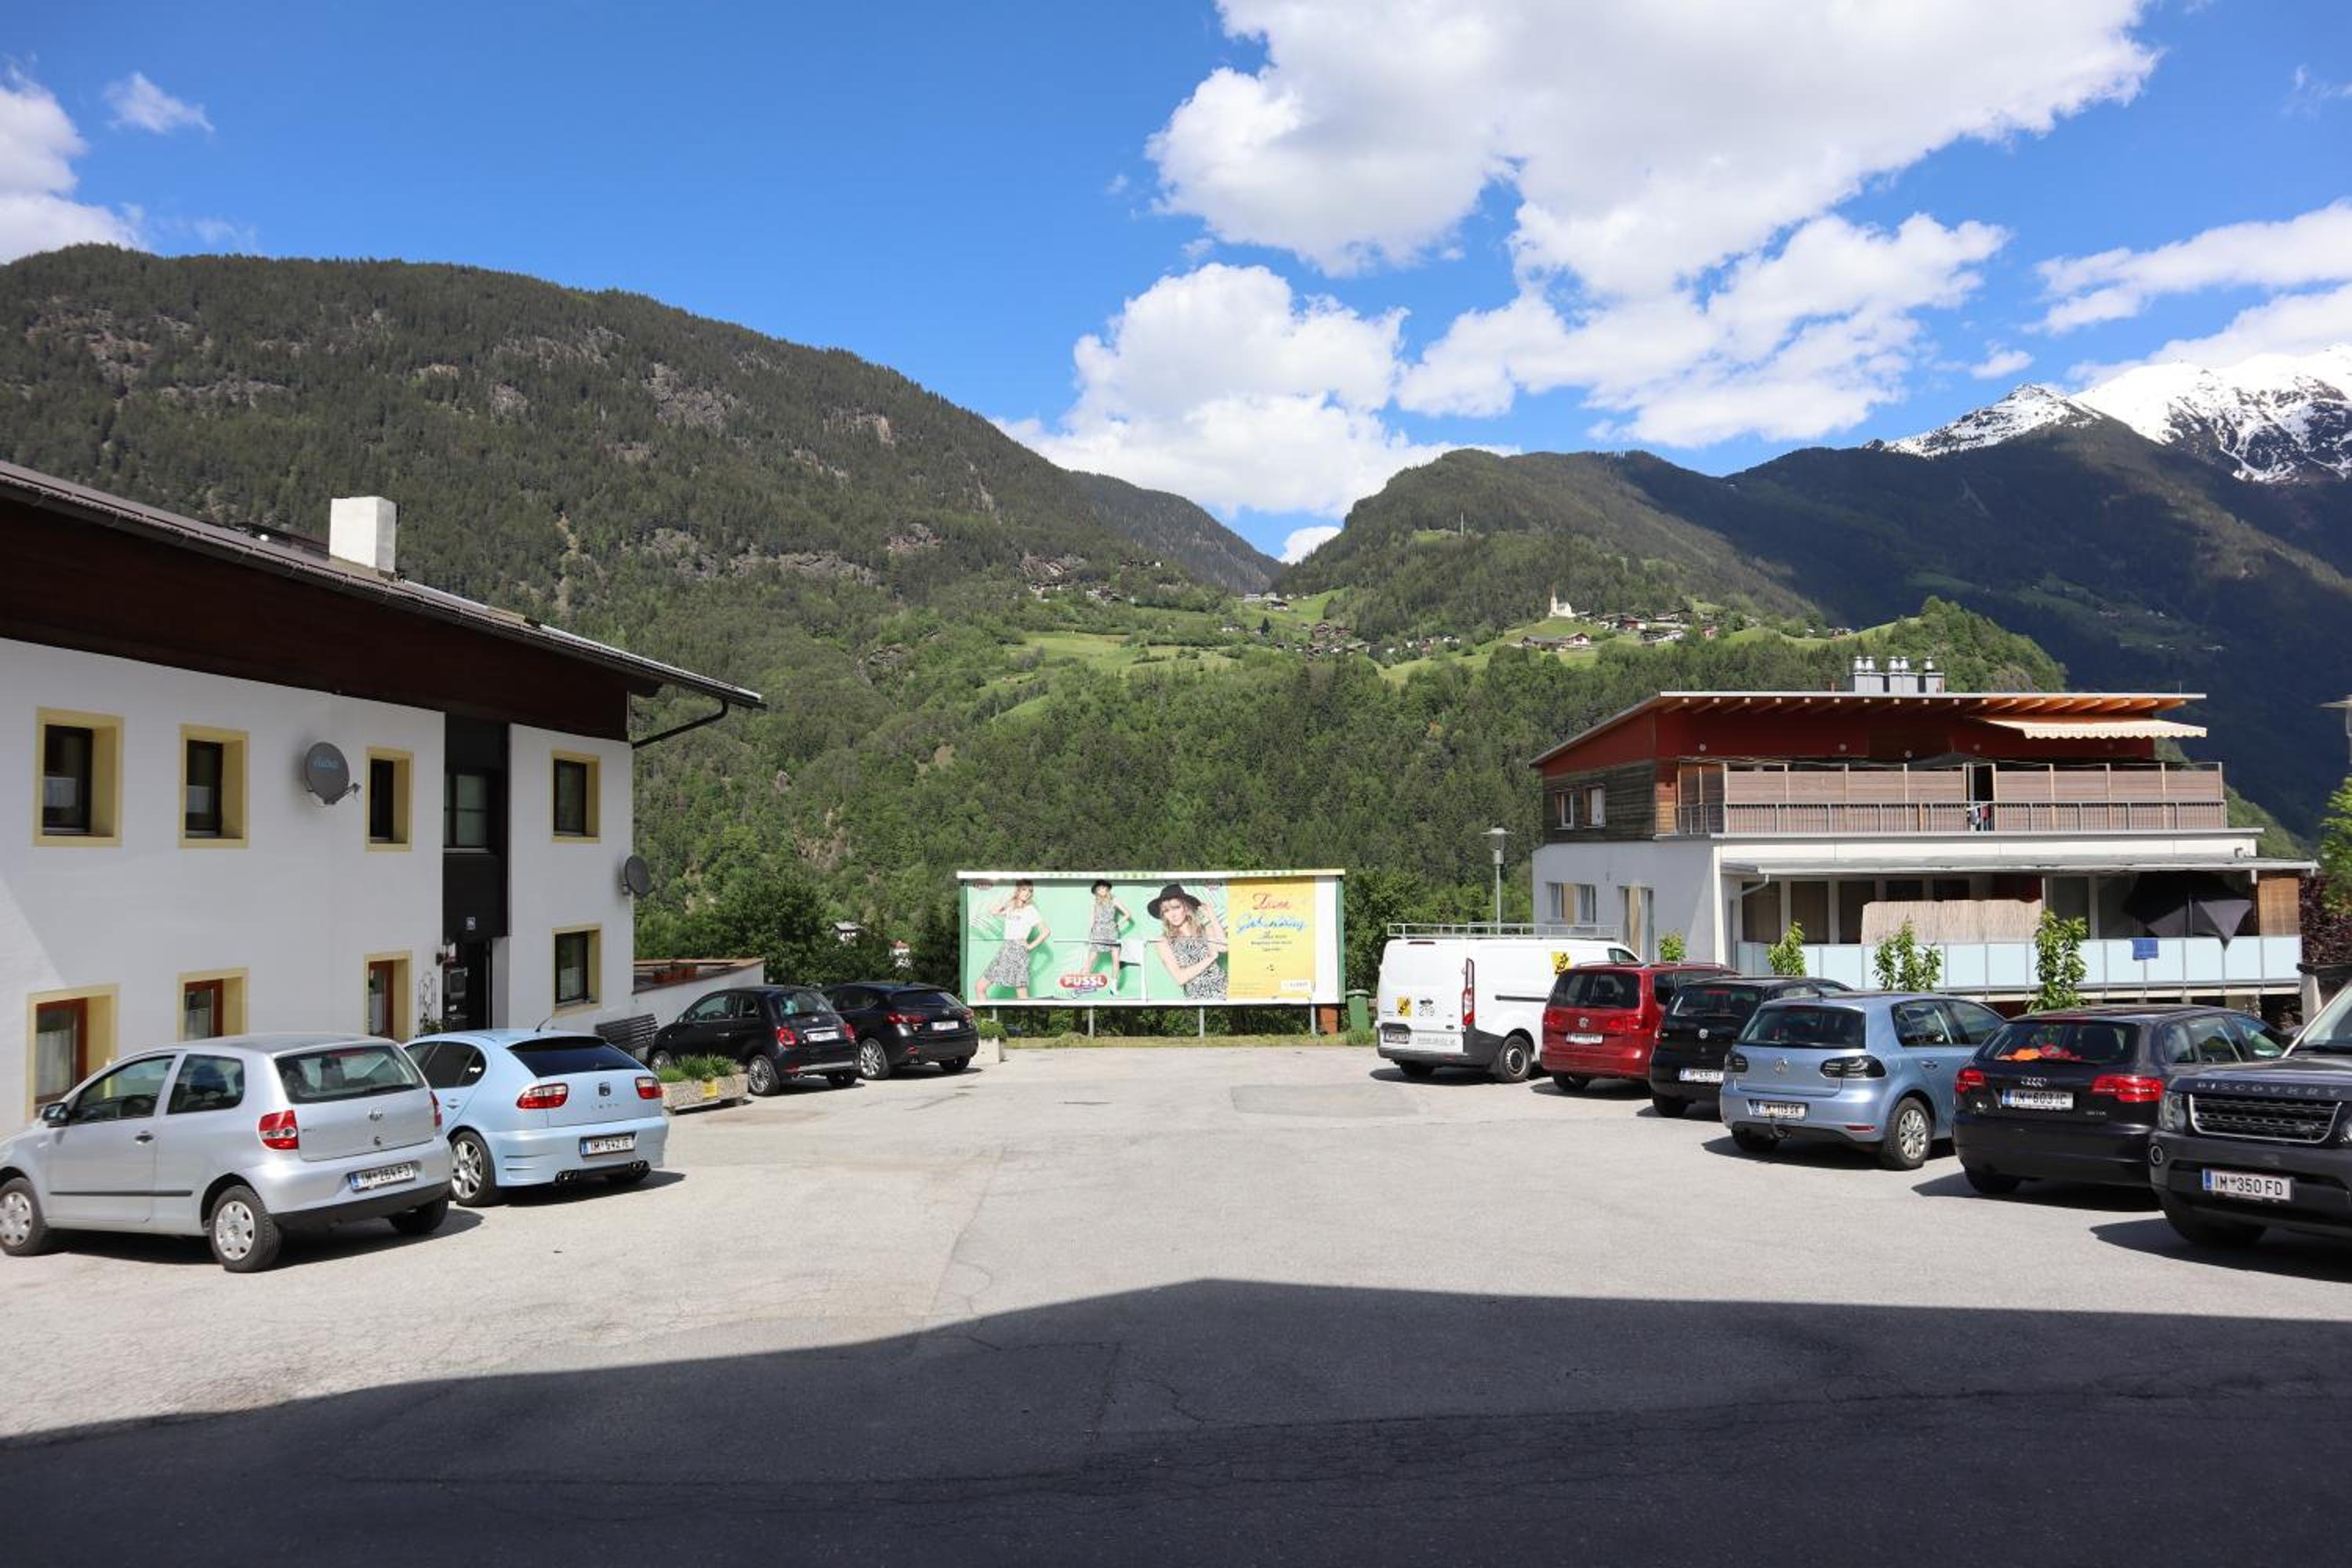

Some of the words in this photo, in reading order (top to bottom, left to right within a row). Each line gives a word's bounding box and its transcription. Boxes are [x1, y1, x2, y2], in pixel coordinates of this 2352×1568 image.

[1064, 975, 1105, 986] FUSSL
[2033, 1091, 2053, 1105] 603
[2215, 1174, 2227, 1189] IM
[2237, 1177, 2262, 1194] 350
[2265, 1180, 2283, 1196] FD
